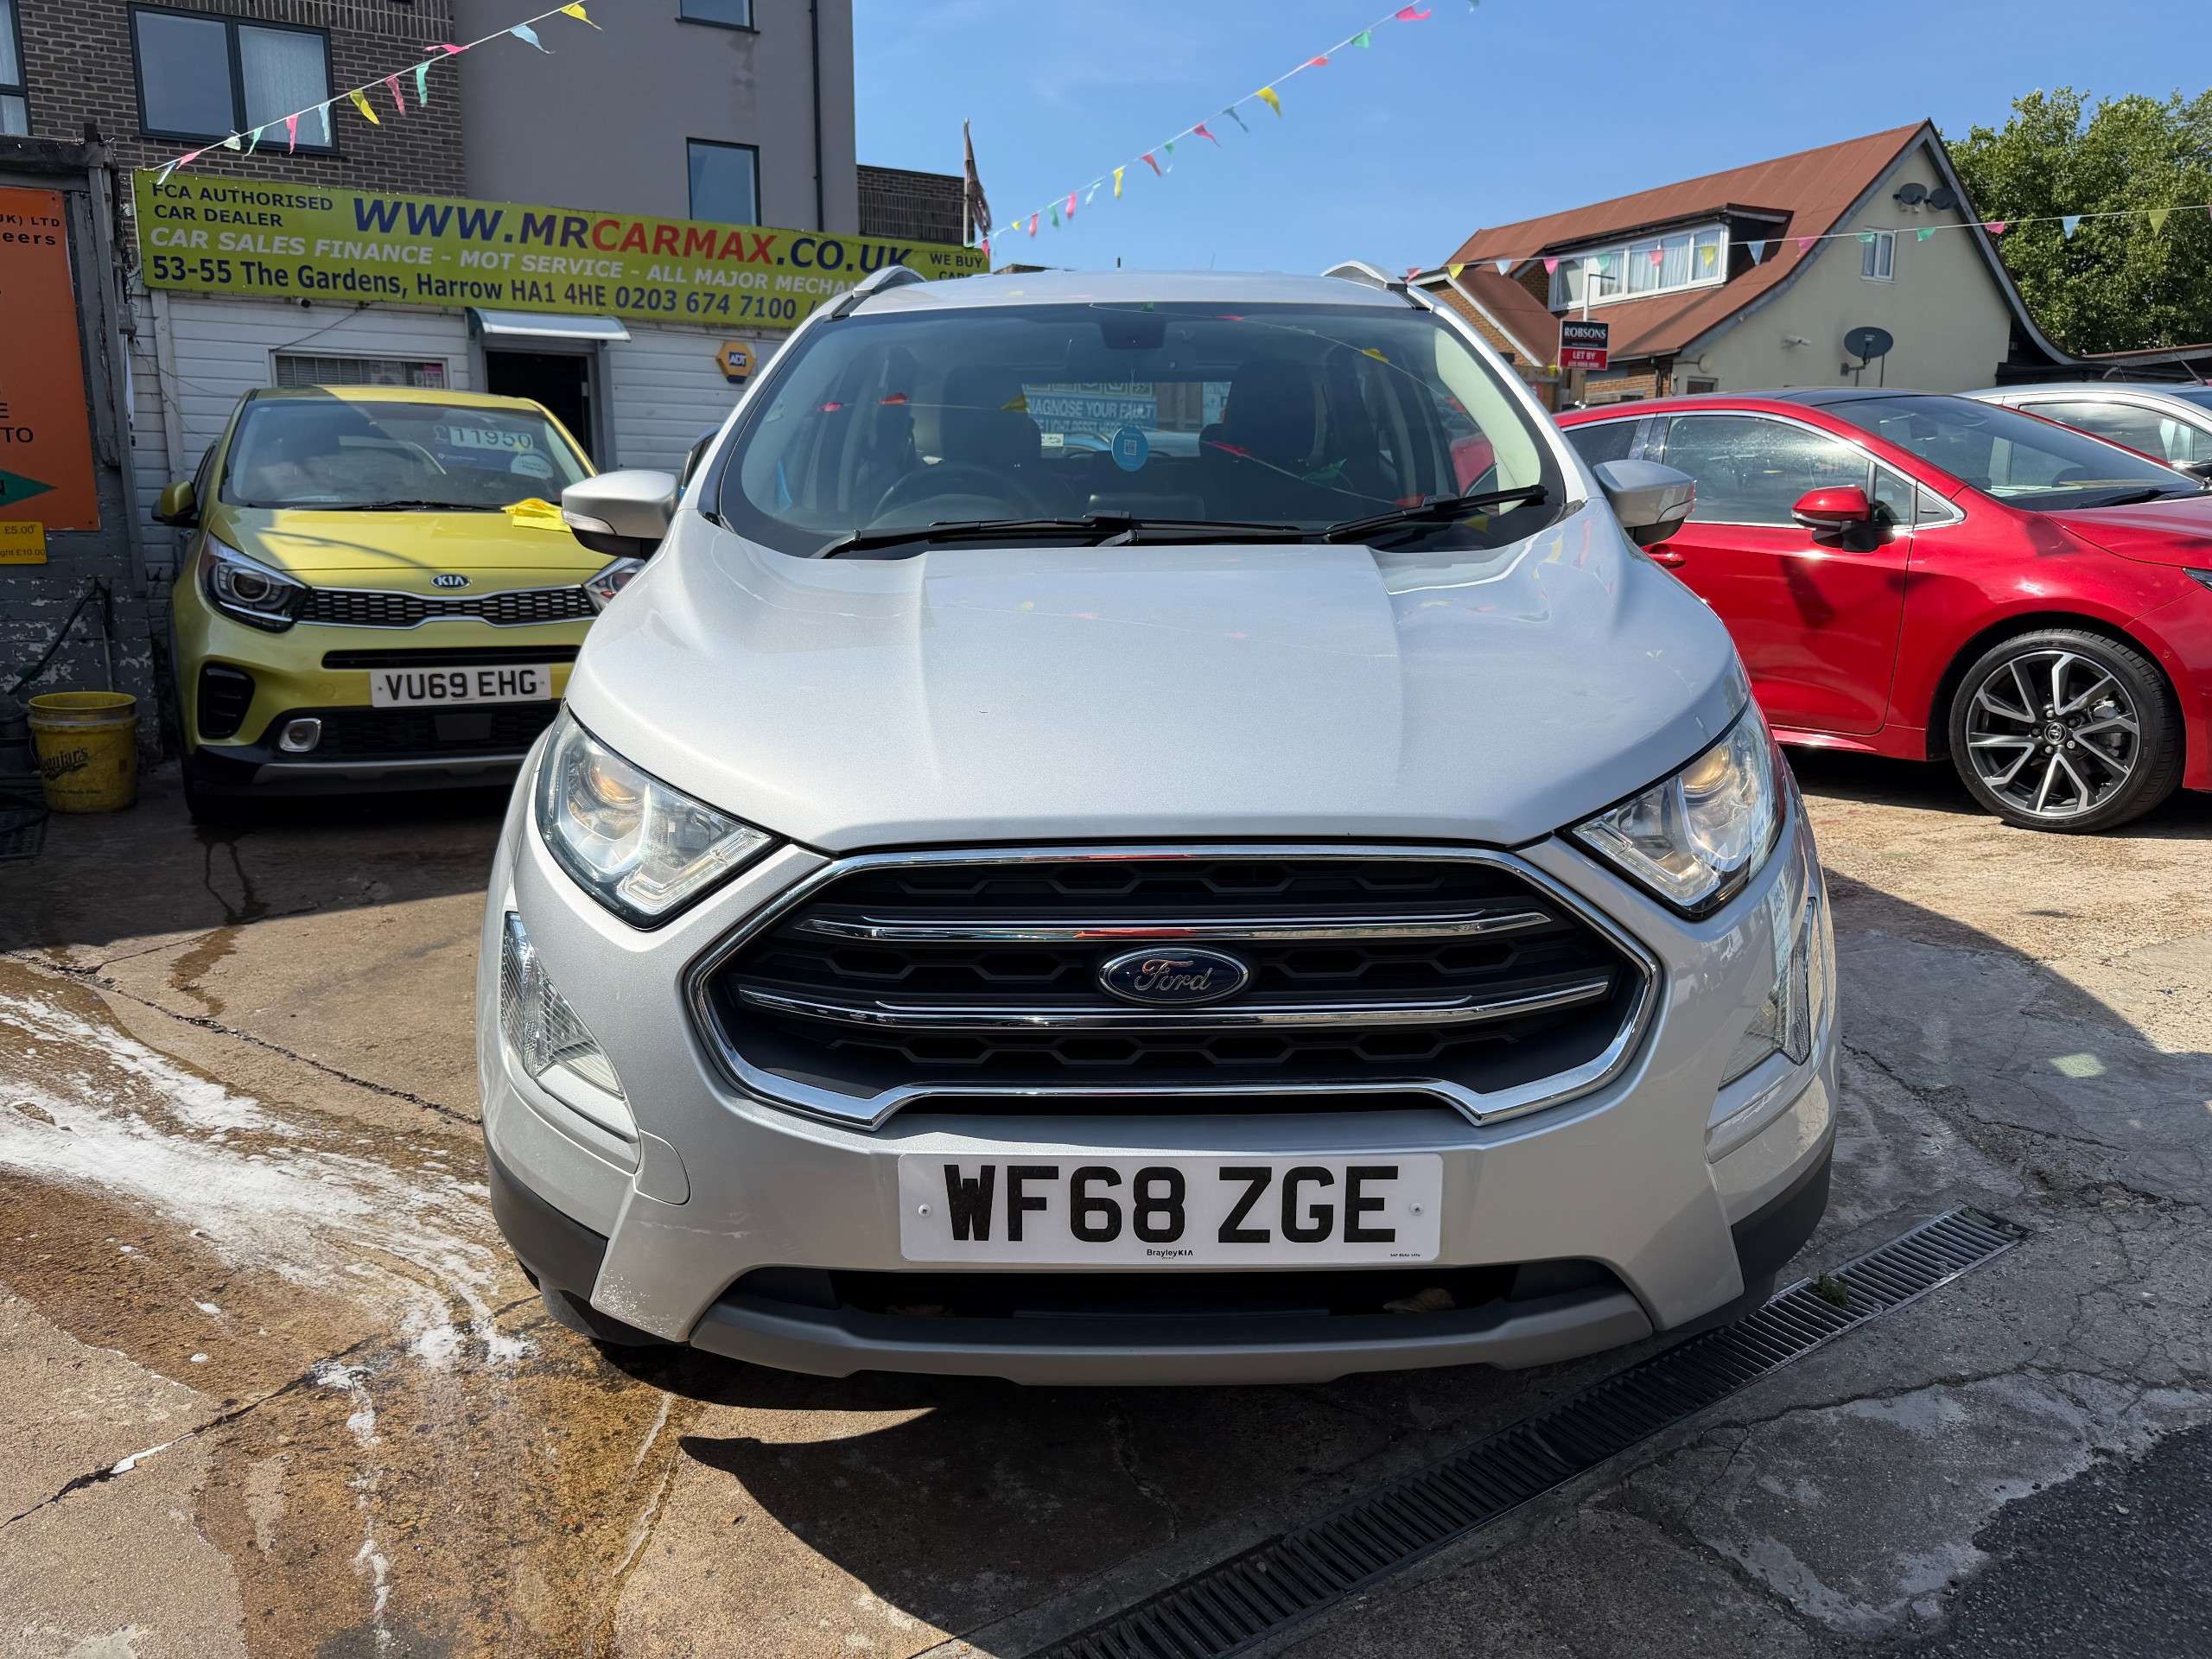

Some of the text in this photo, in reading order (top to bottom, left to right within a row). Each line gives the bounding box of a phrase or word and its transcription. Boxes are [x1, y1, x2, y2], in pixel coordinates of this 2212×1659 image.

[152, 183, 334, 211] FCA AUTHORISED
[31, 216, 60, 227] LTD
[154, 204, 283, 227] CAR DEALER
[150, 227, 208, 250] CAR
[218, 232, 305, 256] SALES
[315, 239, 433, 265] FINANCE
[460, 250, 515, 270] MOT
[521, 254, 624, 278] SERVICE
[646, 264, 688, 283] ALL
[694, 268, 767, 290] MAJOR
[774, 275, 856, 296] MECHA
[930, 253, 982, 268] WE BUY
[938, 270, 971, 280] CAR
[153, 256, 232, 283] 53-55
[240, 261, 289, 287] The
[297, 264, 408, 299] Gardens,
[416, 272, 503, 300] Harrow
[512, 279, 556, 303] HA1
[564, 283, 607, 307] 4HE
[615, 286, 677, 312] 0203
[686, 292, 730, 315] 674
[740, 295, 796, 320] 7100
[1564, 327, 1606, 339] ROBSONS
[1572, 350, 1585, 359] LET
[1085, 401, 1117, 418] YOUR
[1120, 402, 1154, 420] FAULT
[437, 575, 465, 587] KIA
[385, 670, 537, 701] VU69 EHG
[1134, 959, 1212, 991] Ford
[944, 1164, 1399, 1243] WF68 ZGE
